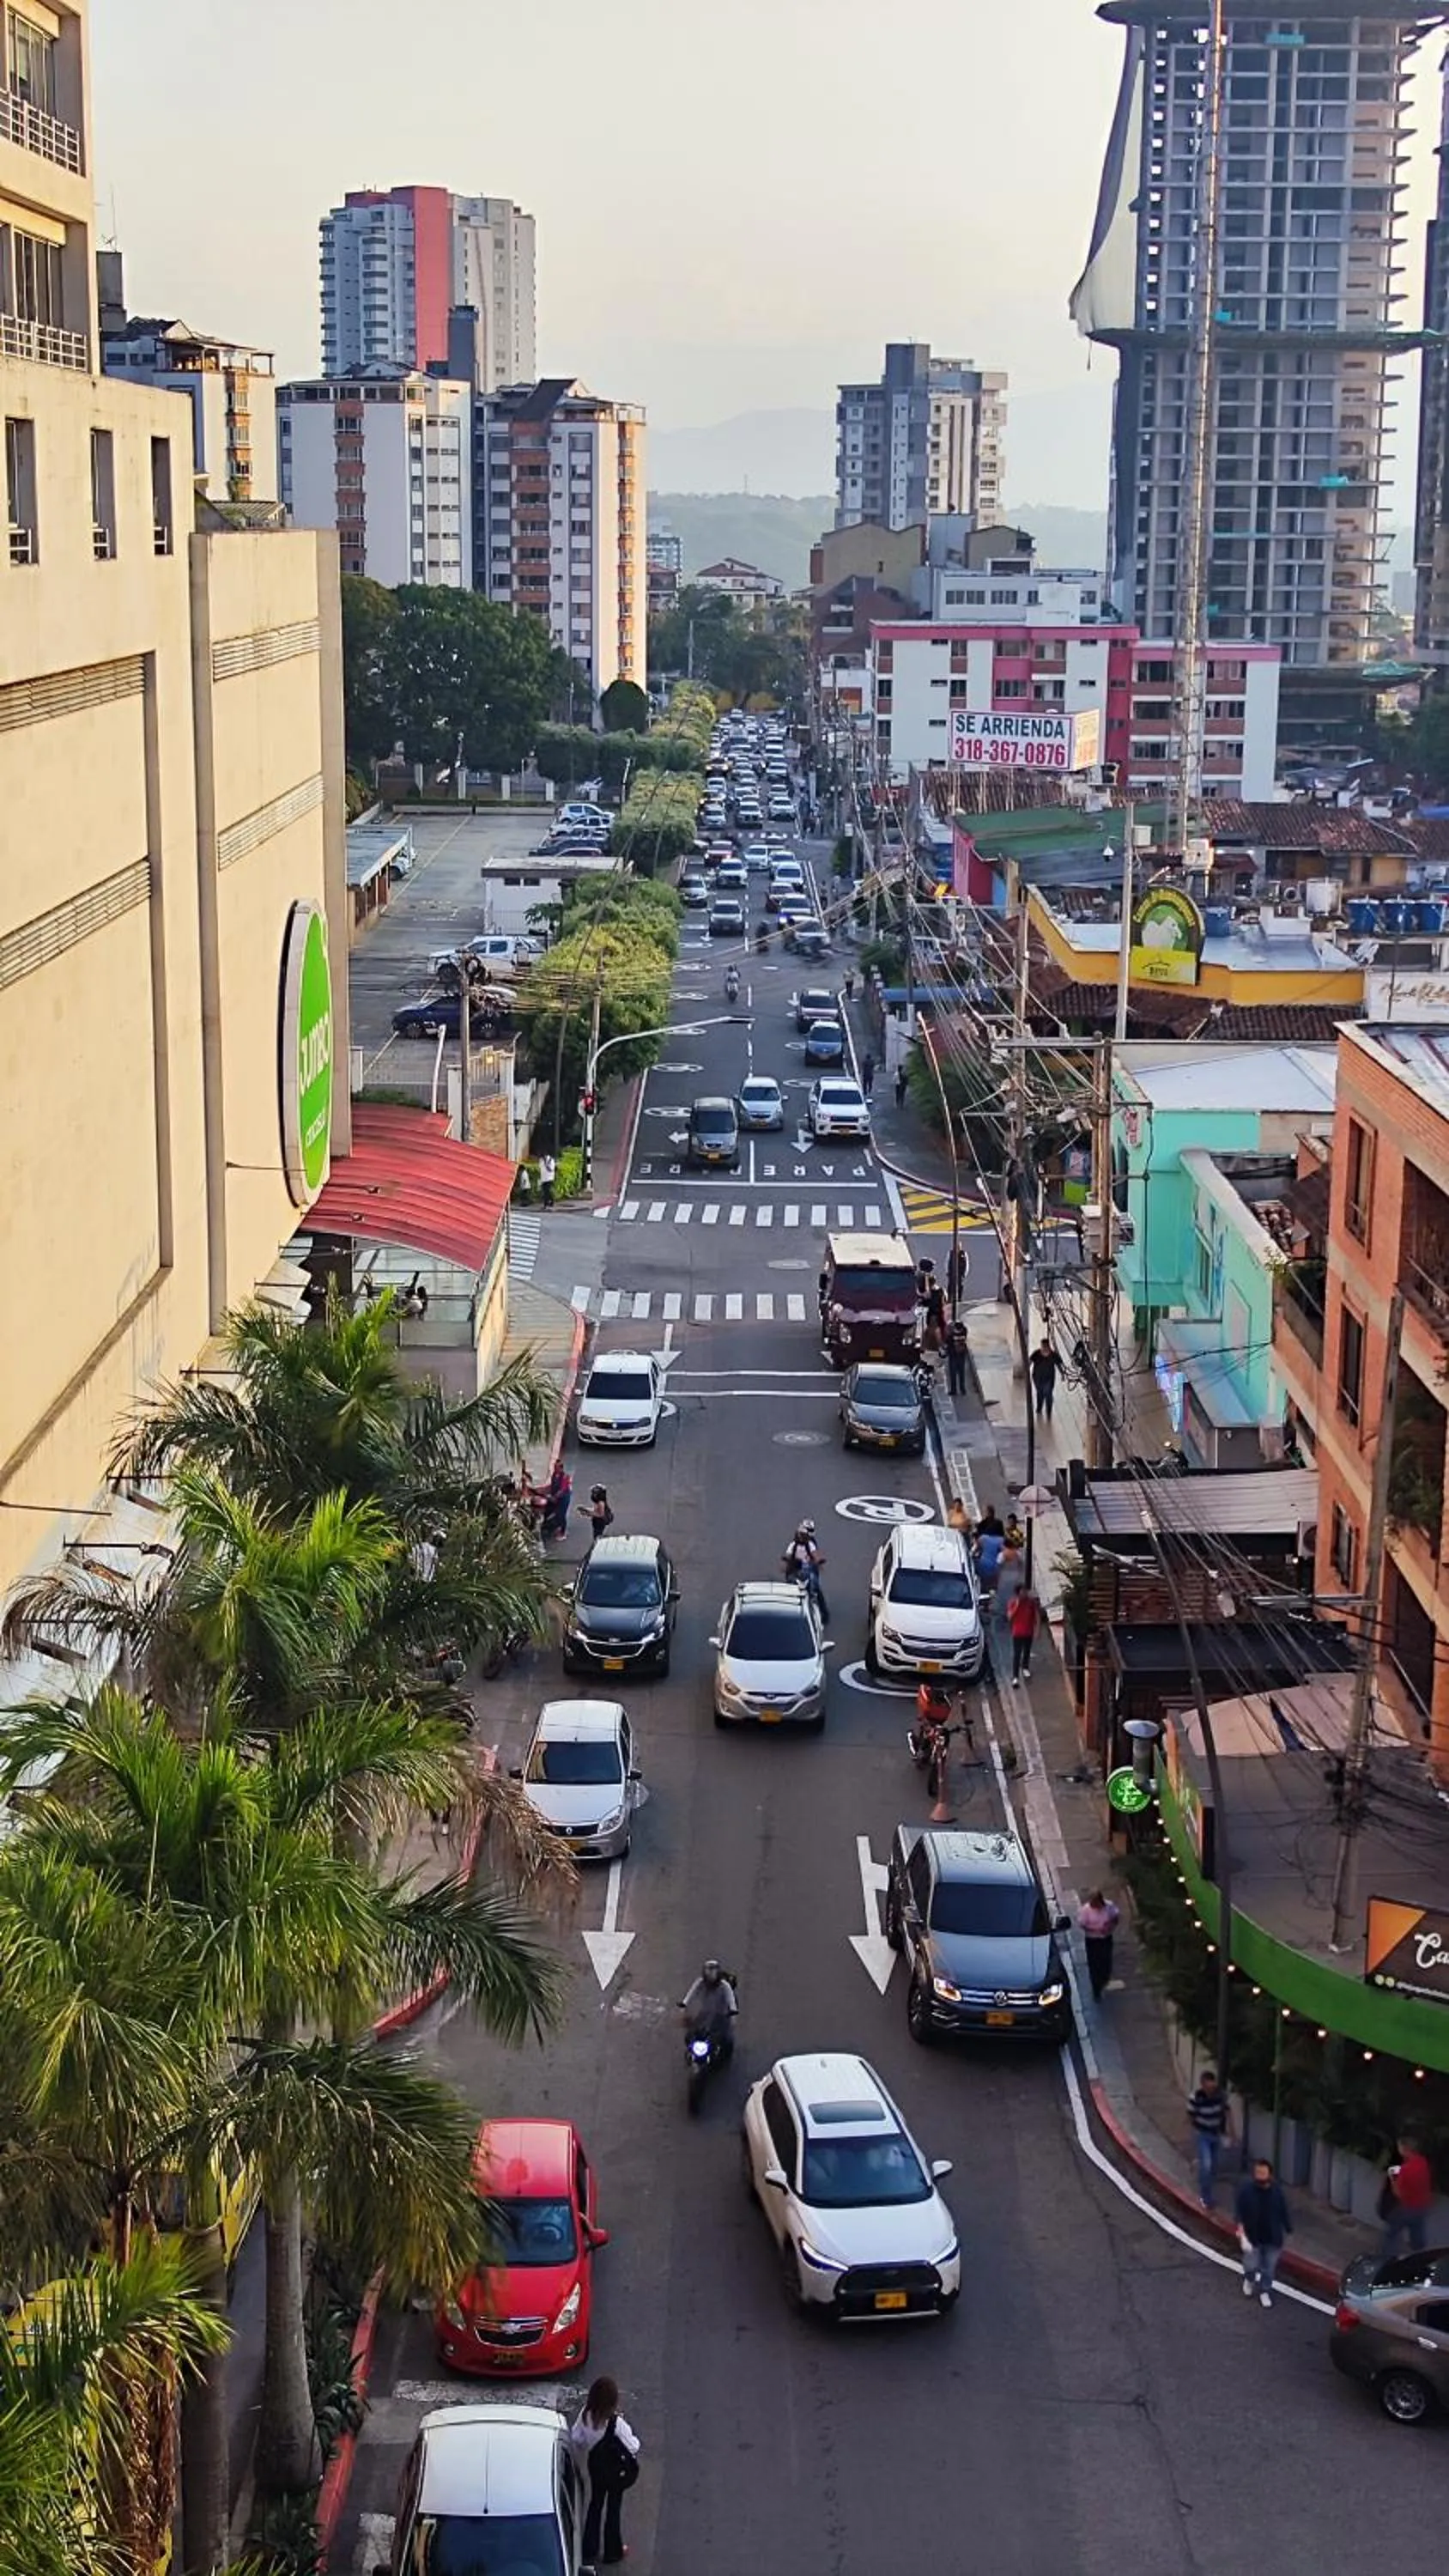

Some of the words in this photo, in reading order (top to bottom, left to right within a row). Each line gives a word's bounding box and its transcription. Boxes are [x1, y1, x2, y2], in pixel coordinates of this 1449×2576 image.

[955, 714, 976, 733] SE
[981, 716, 1065, 739] ARRIENDA
[955, 738, 1065, 766] 318-367-0876
[763, 1164, 866, 1177] PARE
